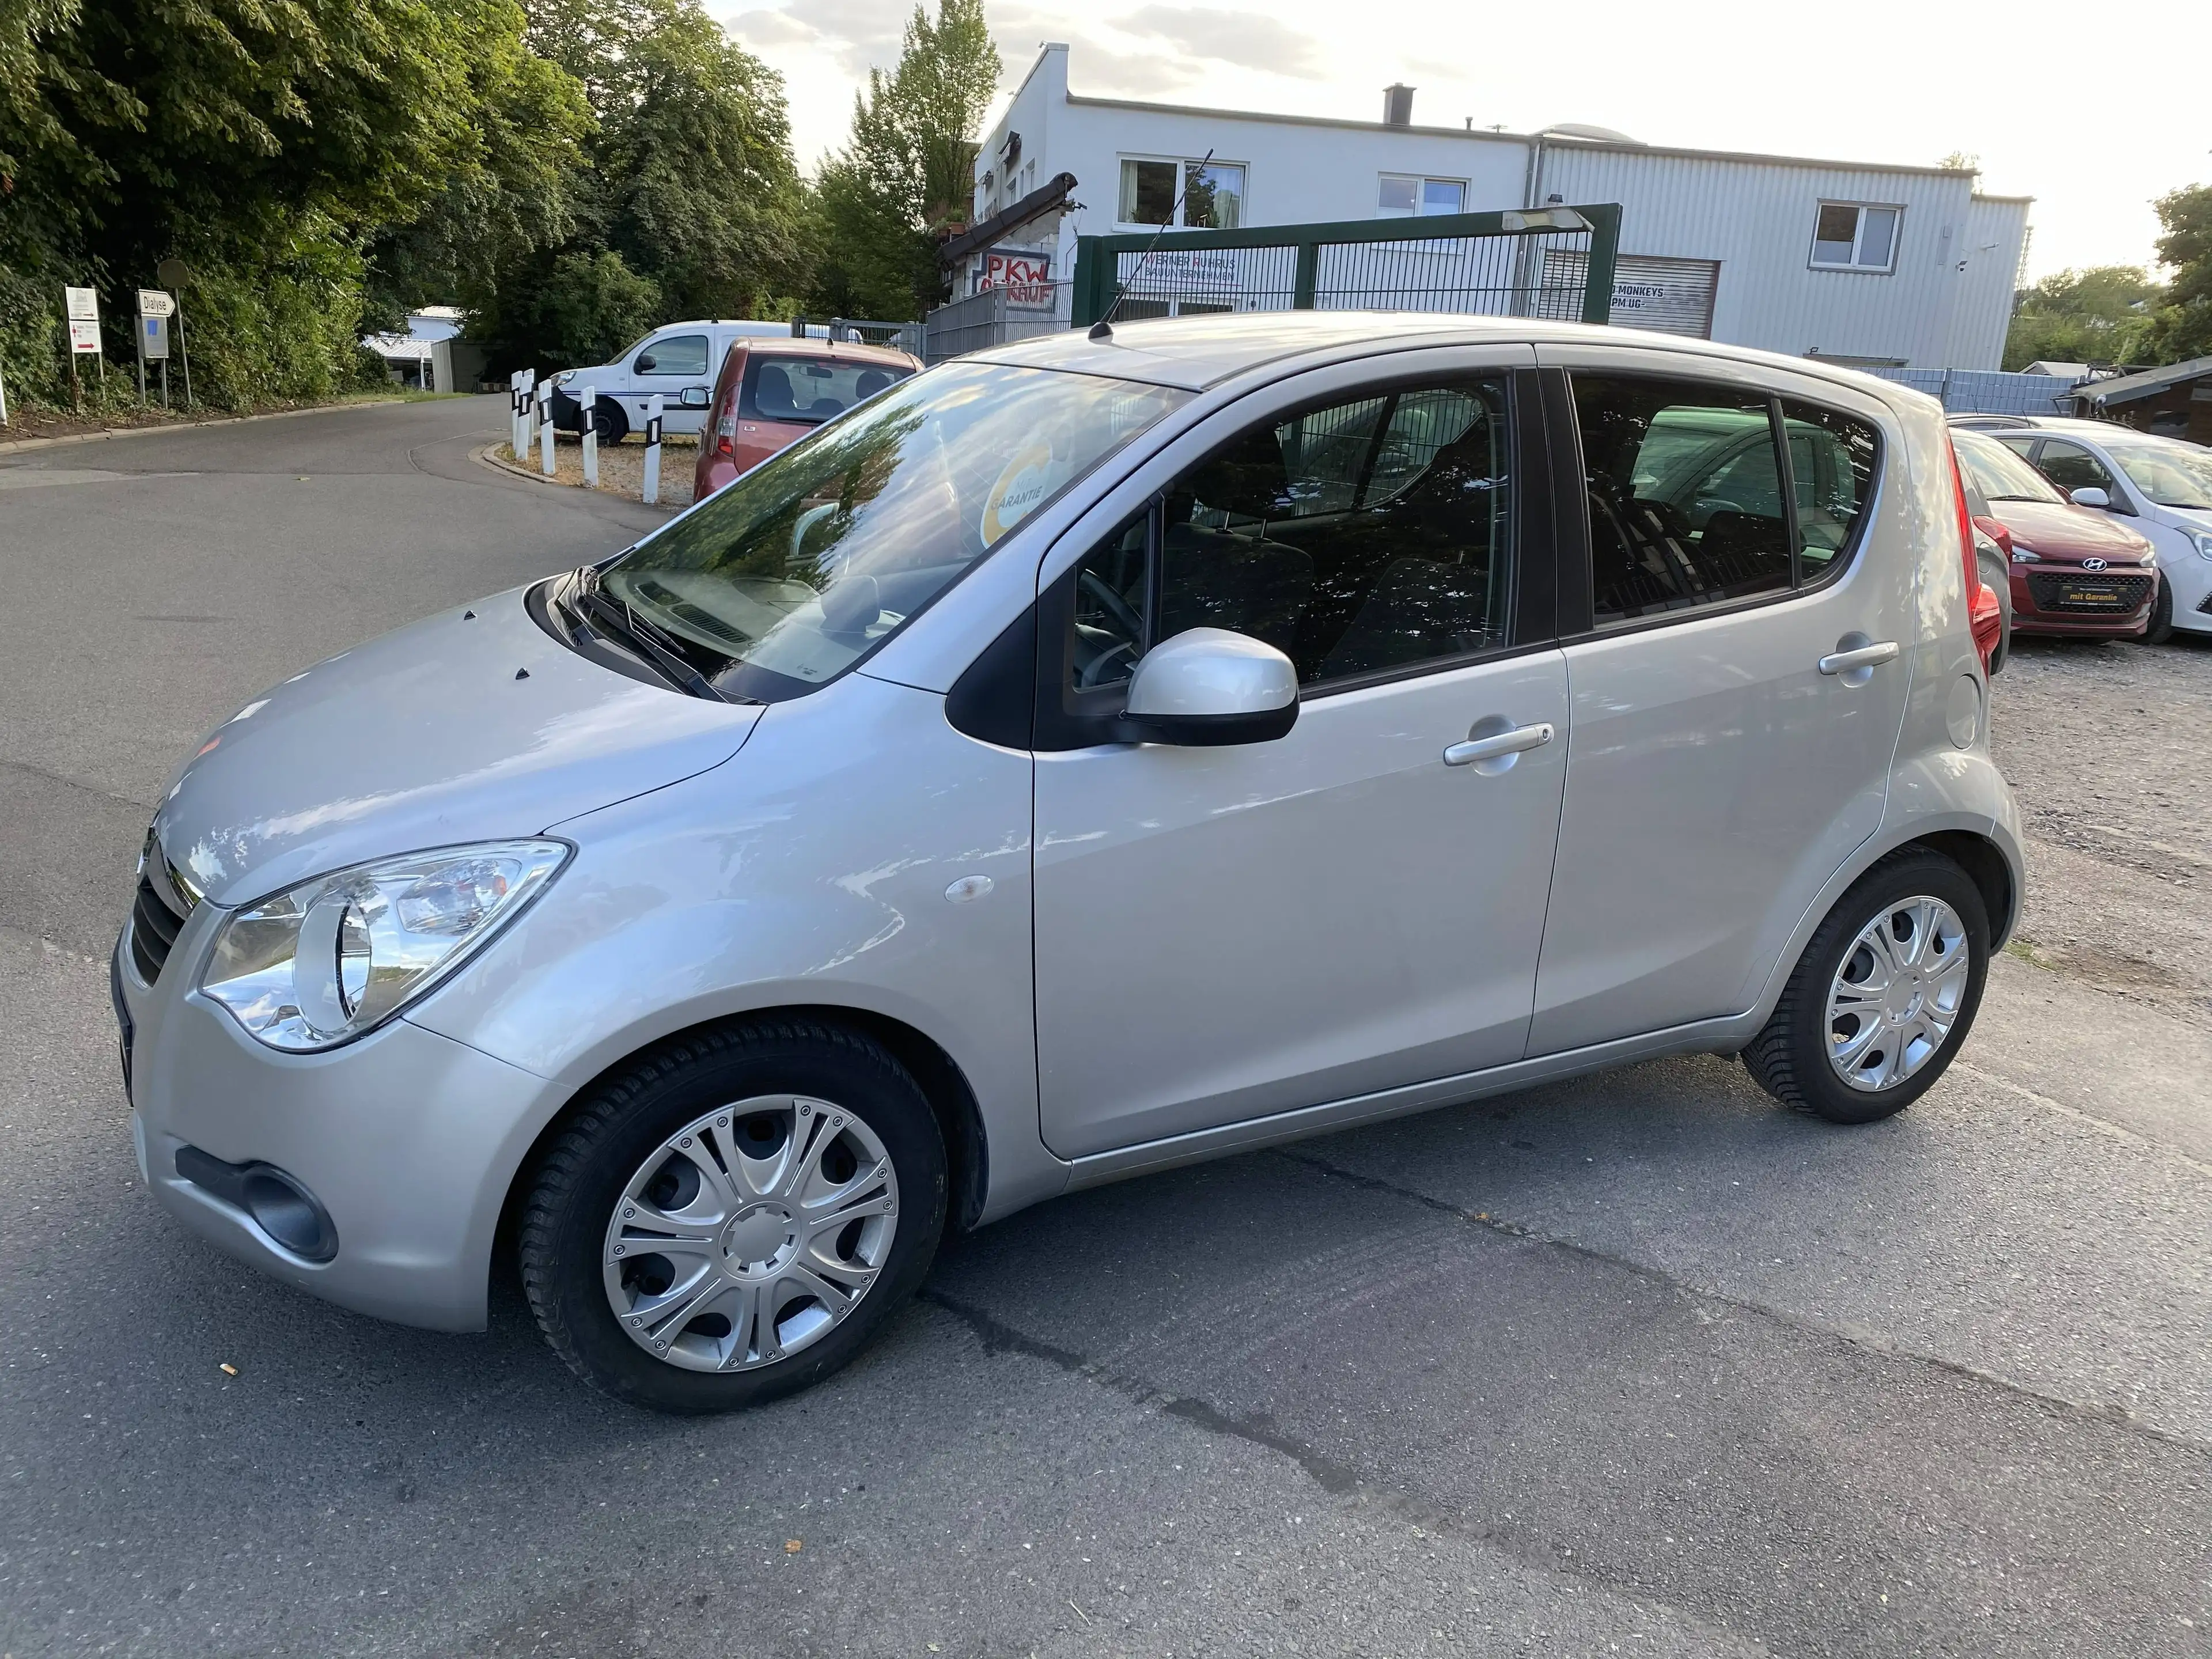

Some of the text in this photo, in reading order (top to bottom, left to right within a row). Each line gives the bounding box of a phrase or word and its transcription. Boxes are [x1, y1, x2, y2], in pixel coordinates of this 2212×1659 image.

[988, 256, 1048, 283] PKW
[1146, 255, 1236, 270] WERNER RUHRUS
[1145, 267, 1234, 281] BAUUNTERNEHMEN
[1619, 285, 1664, 297] MONKEYS
[144, 296, 167, 312] Dialyse
[990, 486, 1043, 511] GARANTIE
[2085, 593, 2118, 601] Garantie
